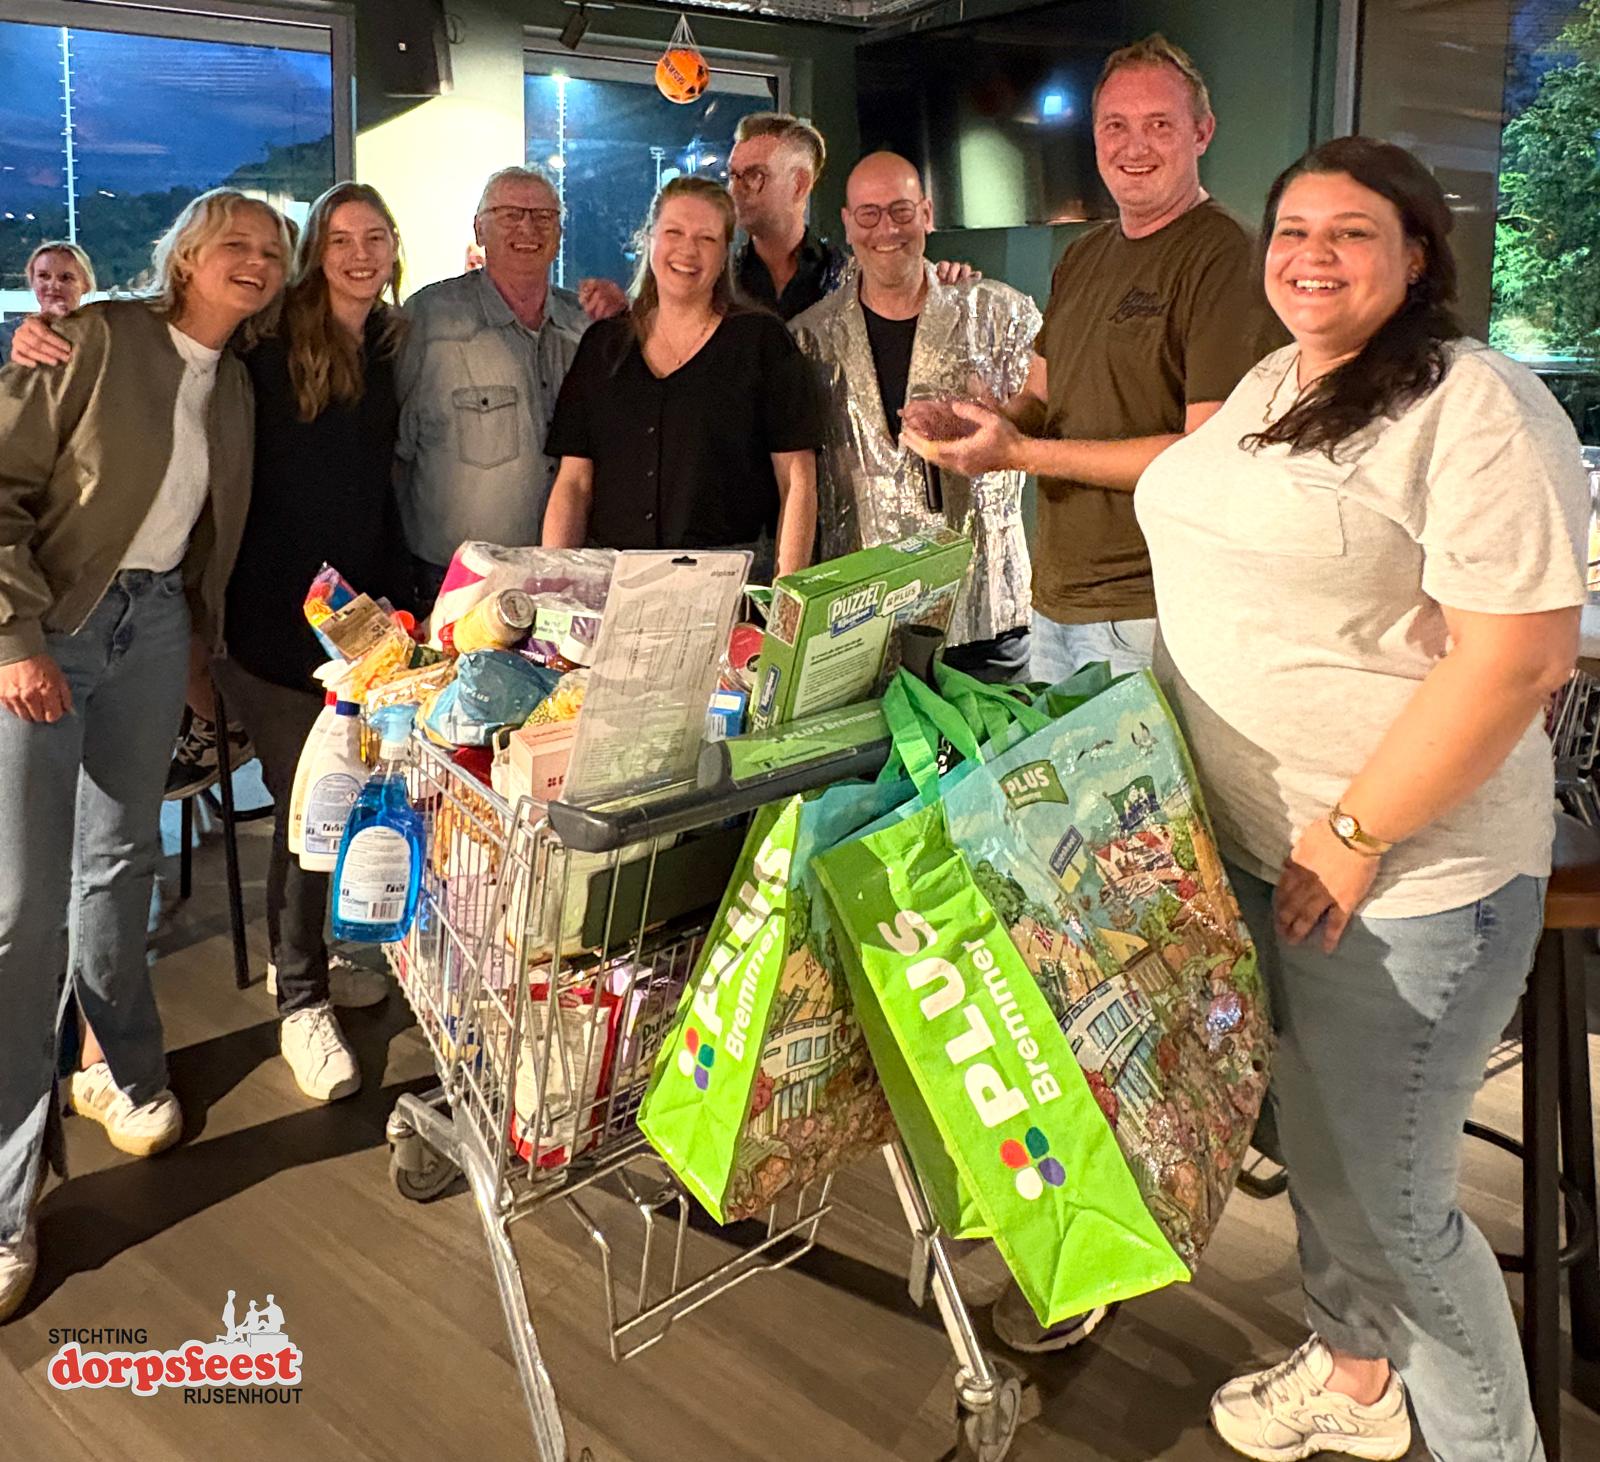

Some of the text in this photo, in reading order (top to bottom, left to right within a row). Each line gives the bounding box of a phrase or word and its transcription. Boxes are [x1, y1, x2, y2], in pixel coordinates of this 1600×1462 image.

[831, 585, 881, 623] PUZZEL
[464, 687, 490, 702] PLUS
[782, 724, 824, 739] PLUS
[1005, 766, 1050, 798] PLUS
[724, 917, 781, 1062] Bremmer
[877, 909, 1030, 1128] PLUS
[961, 938, 1062, 1105] Bremmer
